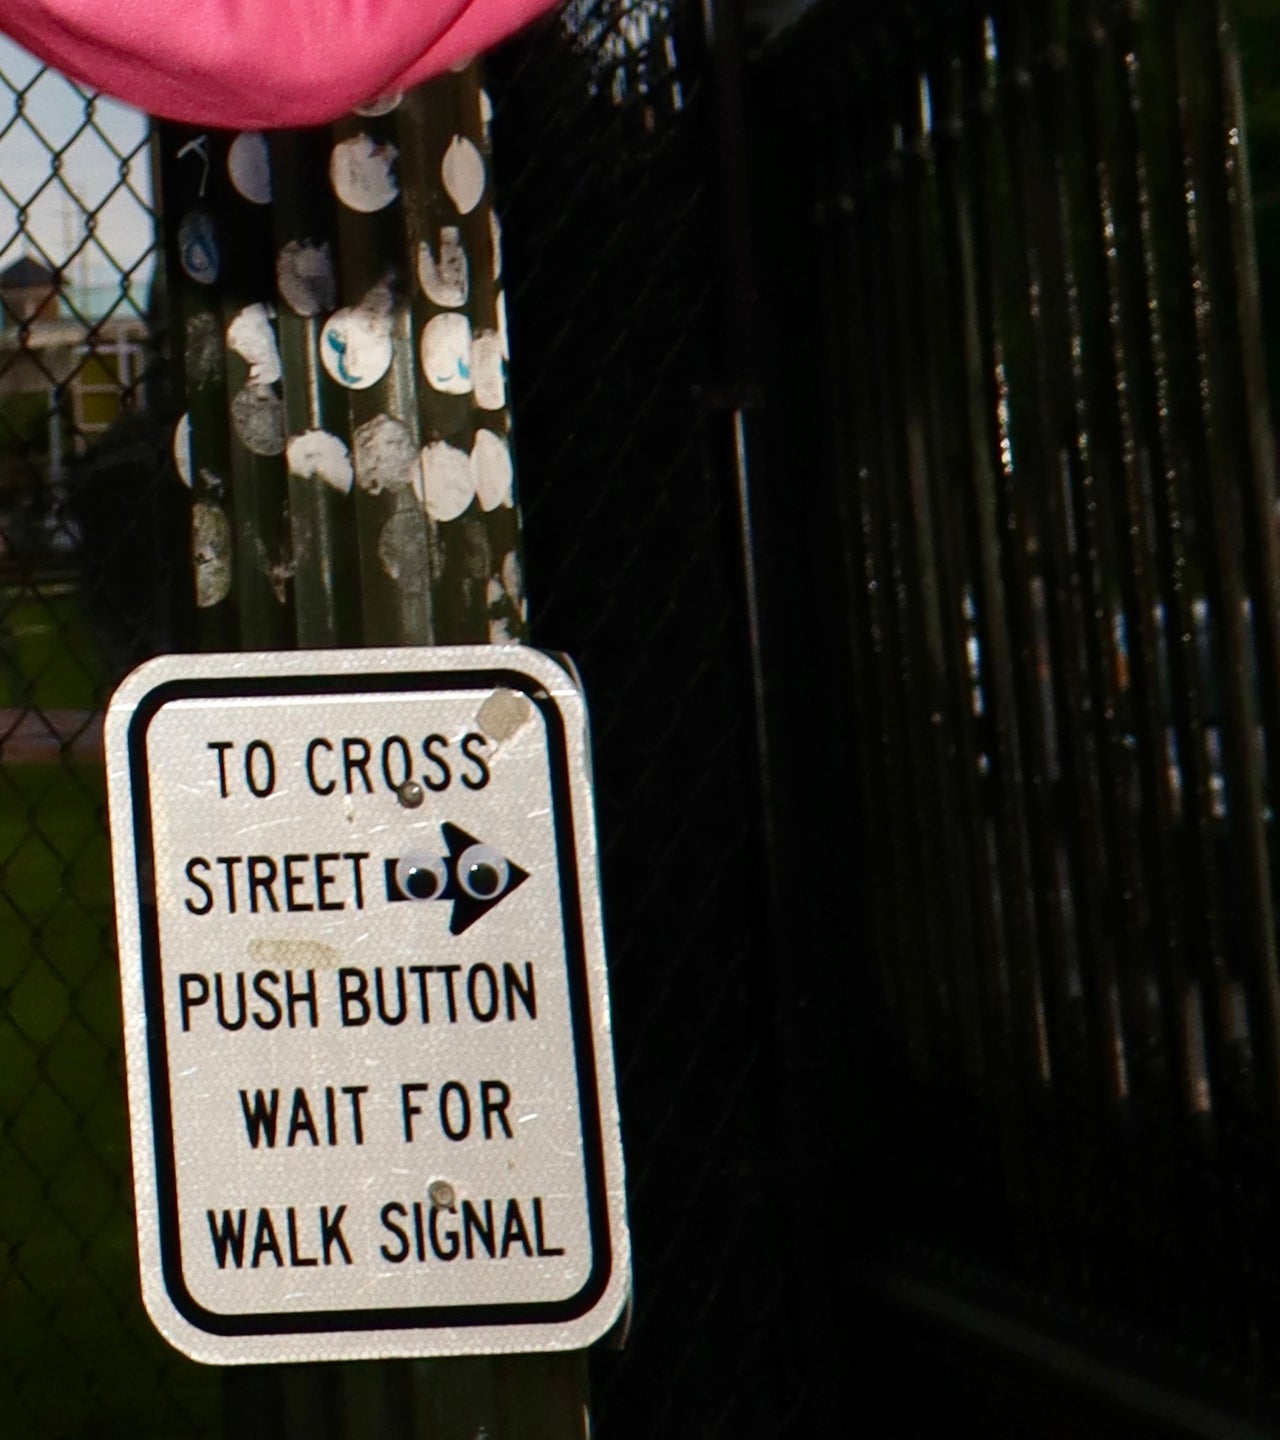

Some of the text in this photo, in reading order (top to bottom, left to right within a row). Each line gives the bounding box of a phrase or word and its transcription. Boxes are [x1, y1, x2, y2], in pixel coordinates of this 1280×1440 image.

[207, 732, 491, 799] TO CROSS
[184, 852, 370, 916] STREET
[179, 961, 538, 1032] PUSH BUTTON
[239, 1080, 514, 1149] WAIT FOR
[206, 1198, 565, 1270] WALK SIGNAL
